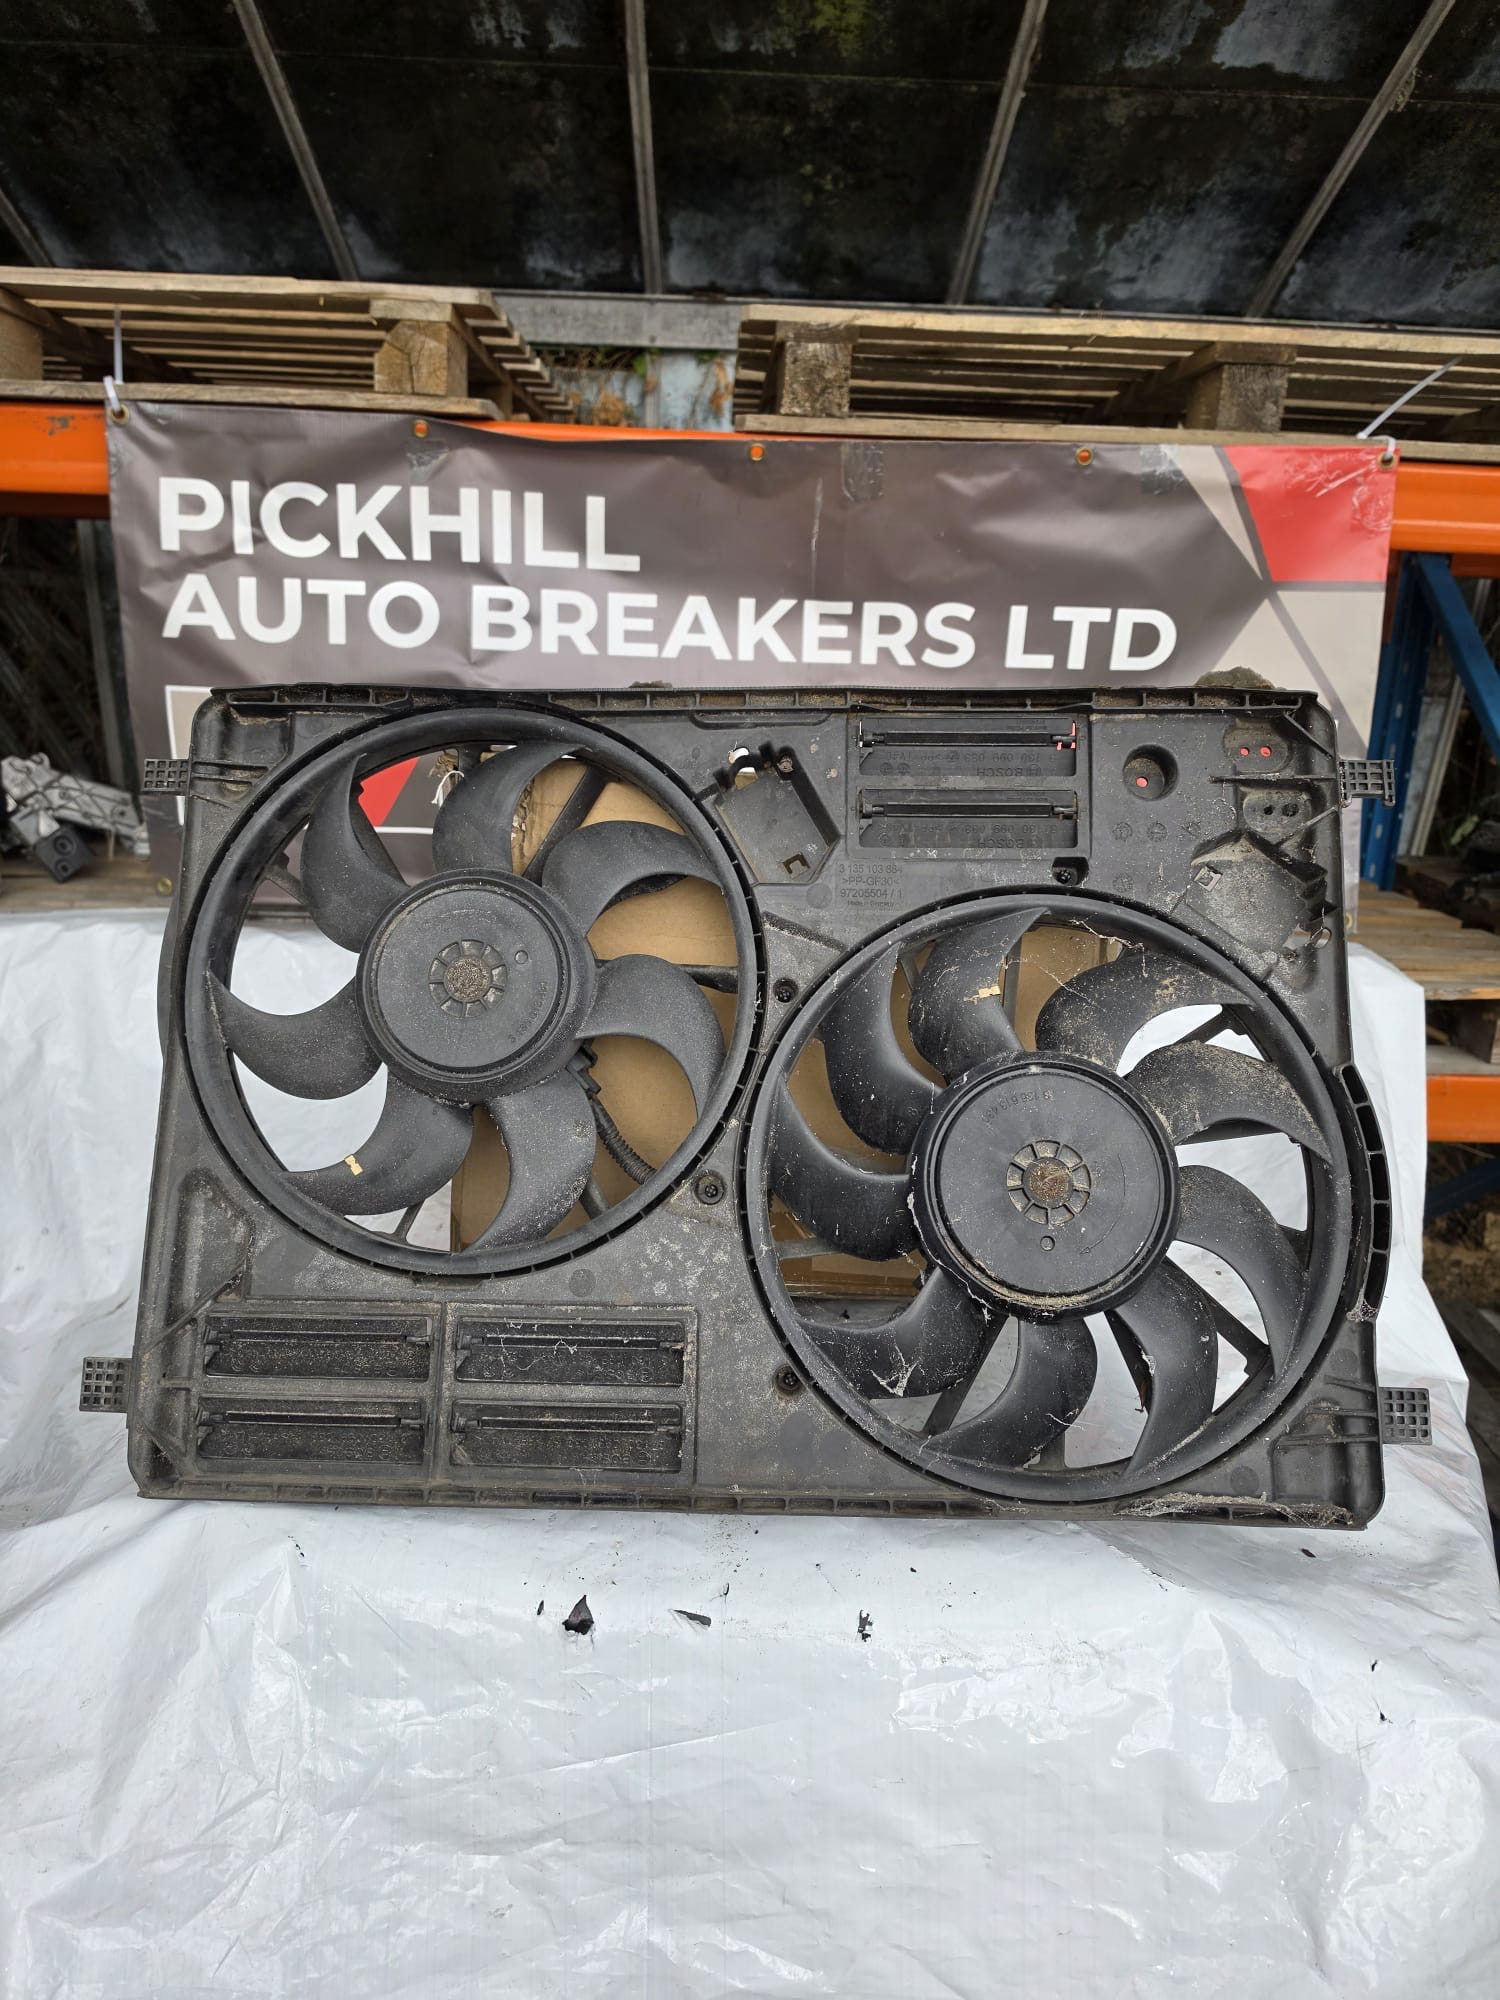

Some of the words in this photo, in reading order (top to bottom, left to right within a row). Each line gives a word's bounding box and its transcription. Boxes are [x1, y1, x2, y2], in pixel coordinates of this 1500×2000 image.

[158, 475, 641, 573] PICKHILL
[162, 572, 441, 649] AUTO
[470, 583, 976, 668] BREAKERS
[1004, 605, 1177, 671] LTD
[976, 767, 1023, 777] BOSCH
[976, 838, 1023, 849] BOSCH
[839, 863, 845, 873] 3
